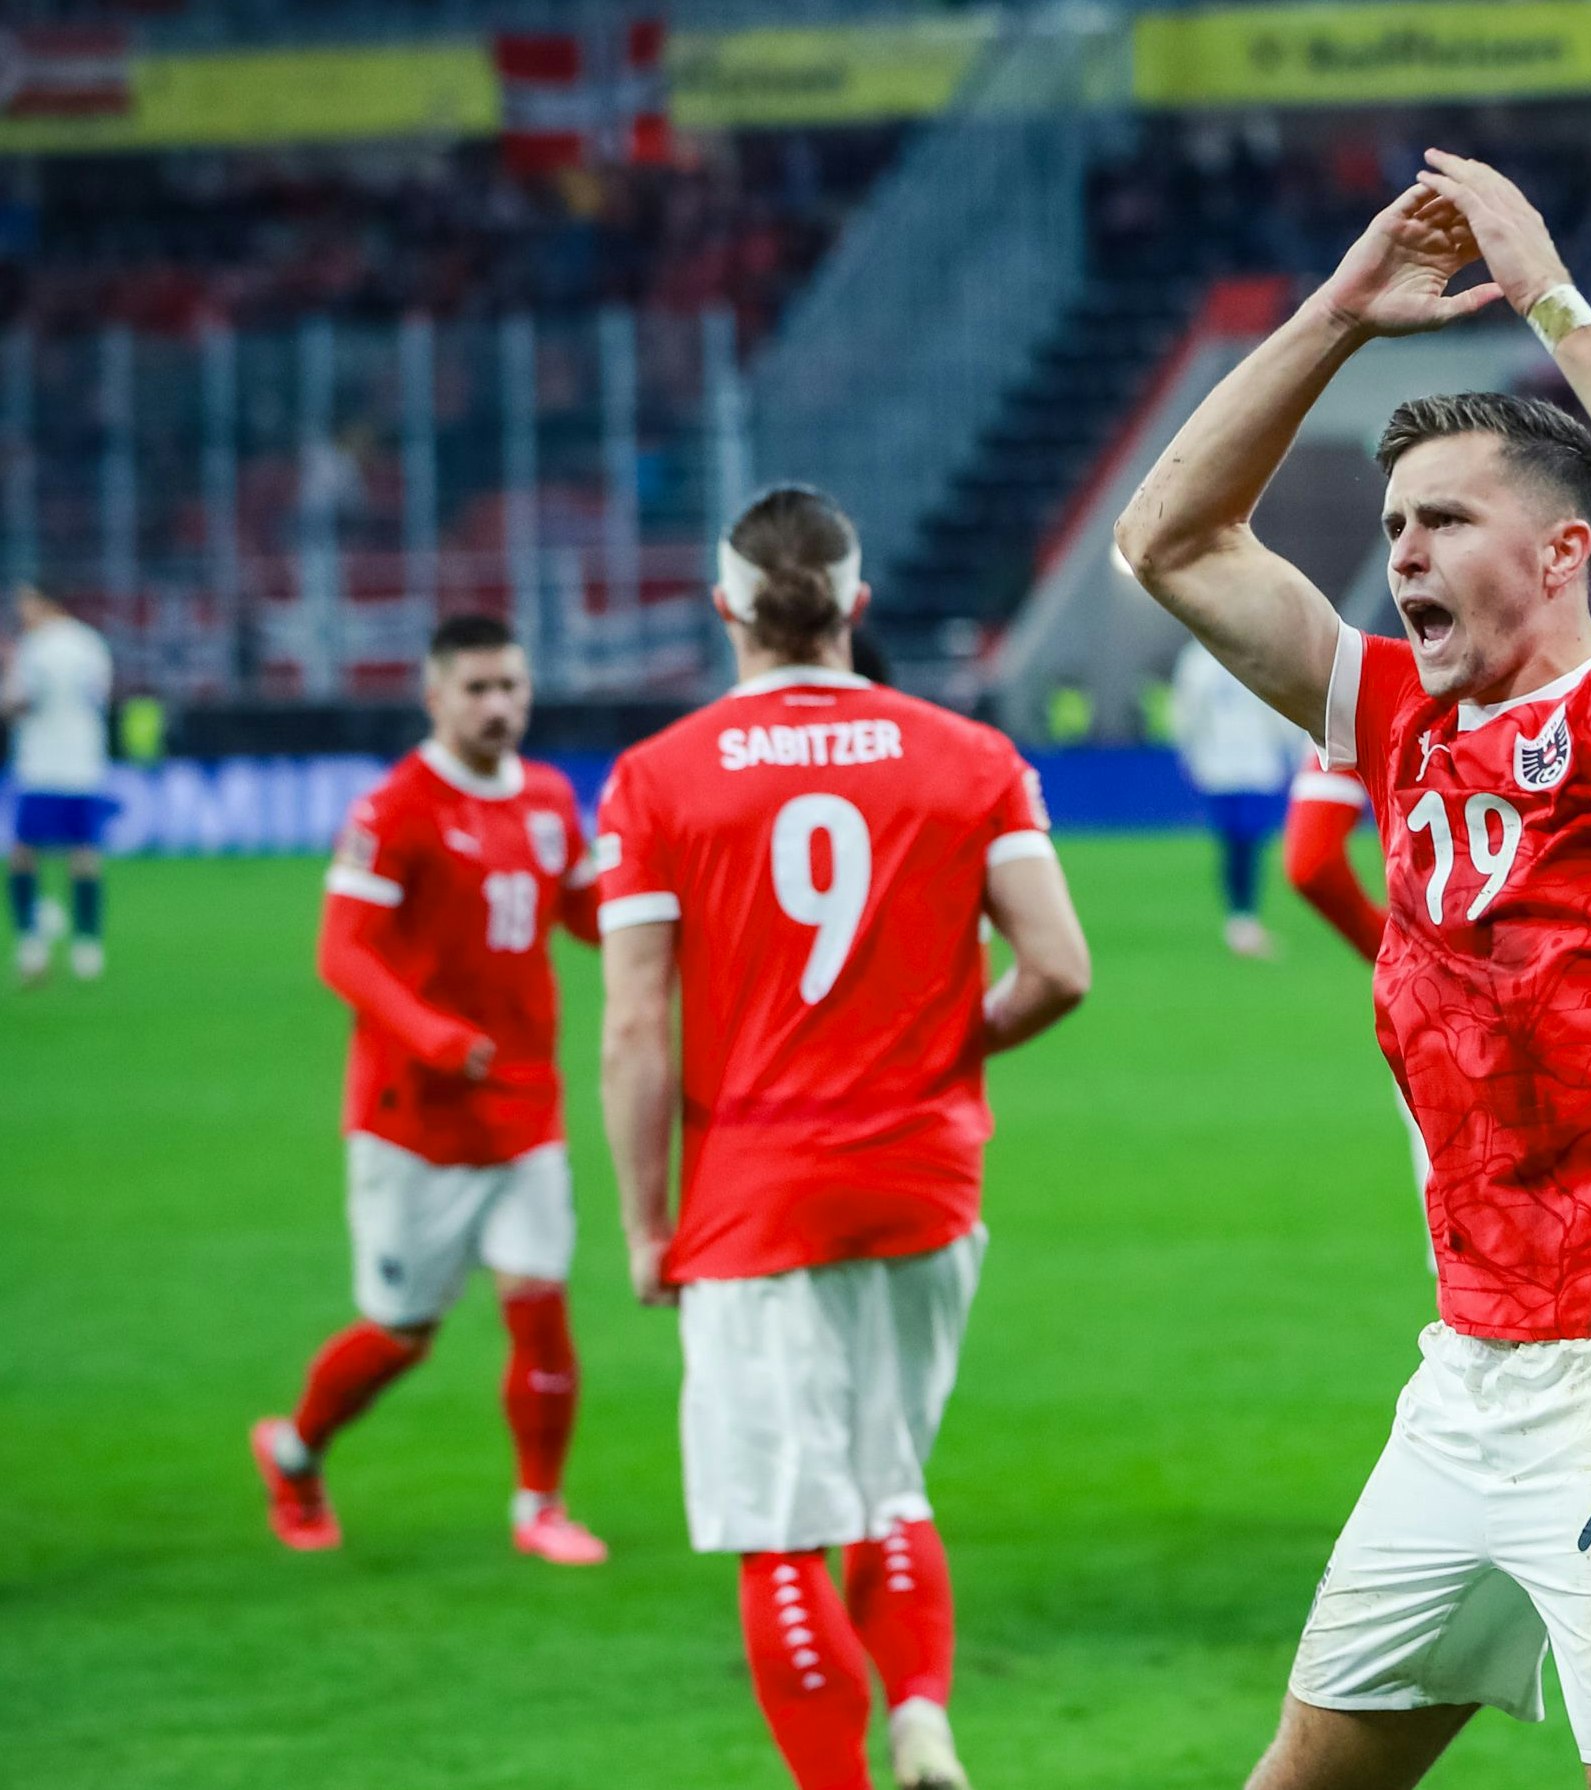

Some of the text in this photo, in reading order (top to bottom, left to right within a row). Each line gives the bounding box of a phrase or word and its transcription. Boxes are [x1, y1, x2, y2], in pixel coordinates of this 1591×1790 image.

[717, 719, 903, 771] SABITZER
[771, 792, 872, 1005] 9
[1406, 790, 1522, 925] 19
